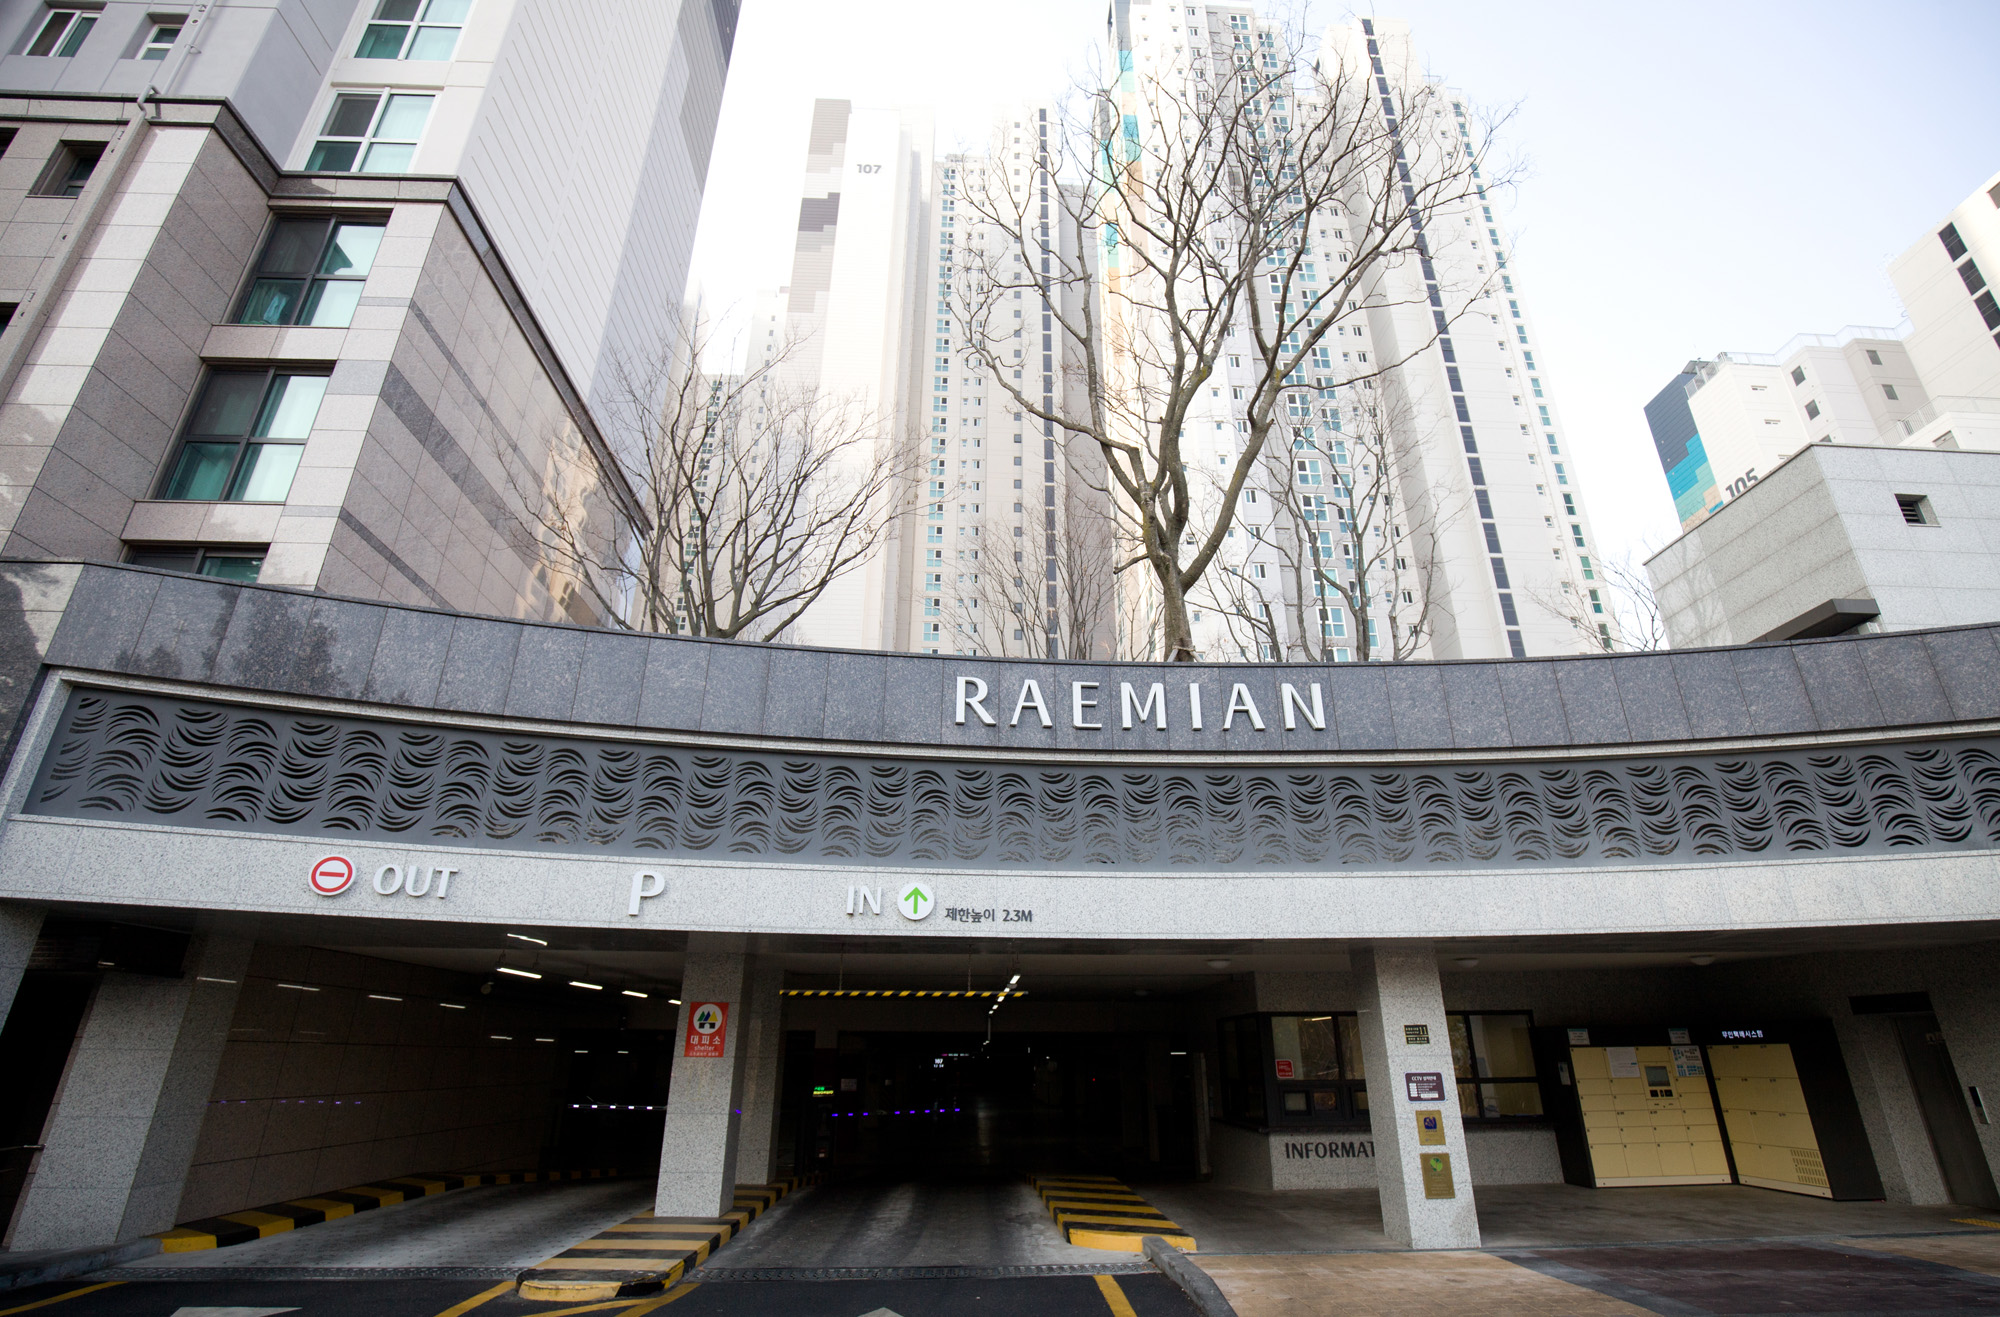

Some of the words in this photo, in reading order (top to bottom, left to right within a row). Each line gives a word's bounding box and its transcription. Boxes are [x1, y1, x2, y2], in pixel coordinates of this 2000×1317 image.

[856, 163, 882, 174] 107
[1725, 467, 1759, 498] 105
[954, 675, 1327, 732] RAEMIAN
[372, 863, 459, 899] OUT
[628, 870, 666, 916] P
[845, 884, 882, 916] IN
[945, 907, 995, 923] 제한높이
[1002, 909, 1033, 923] 2.3M
[1721, 1029, 1764, 1039] 무인택배시스템
